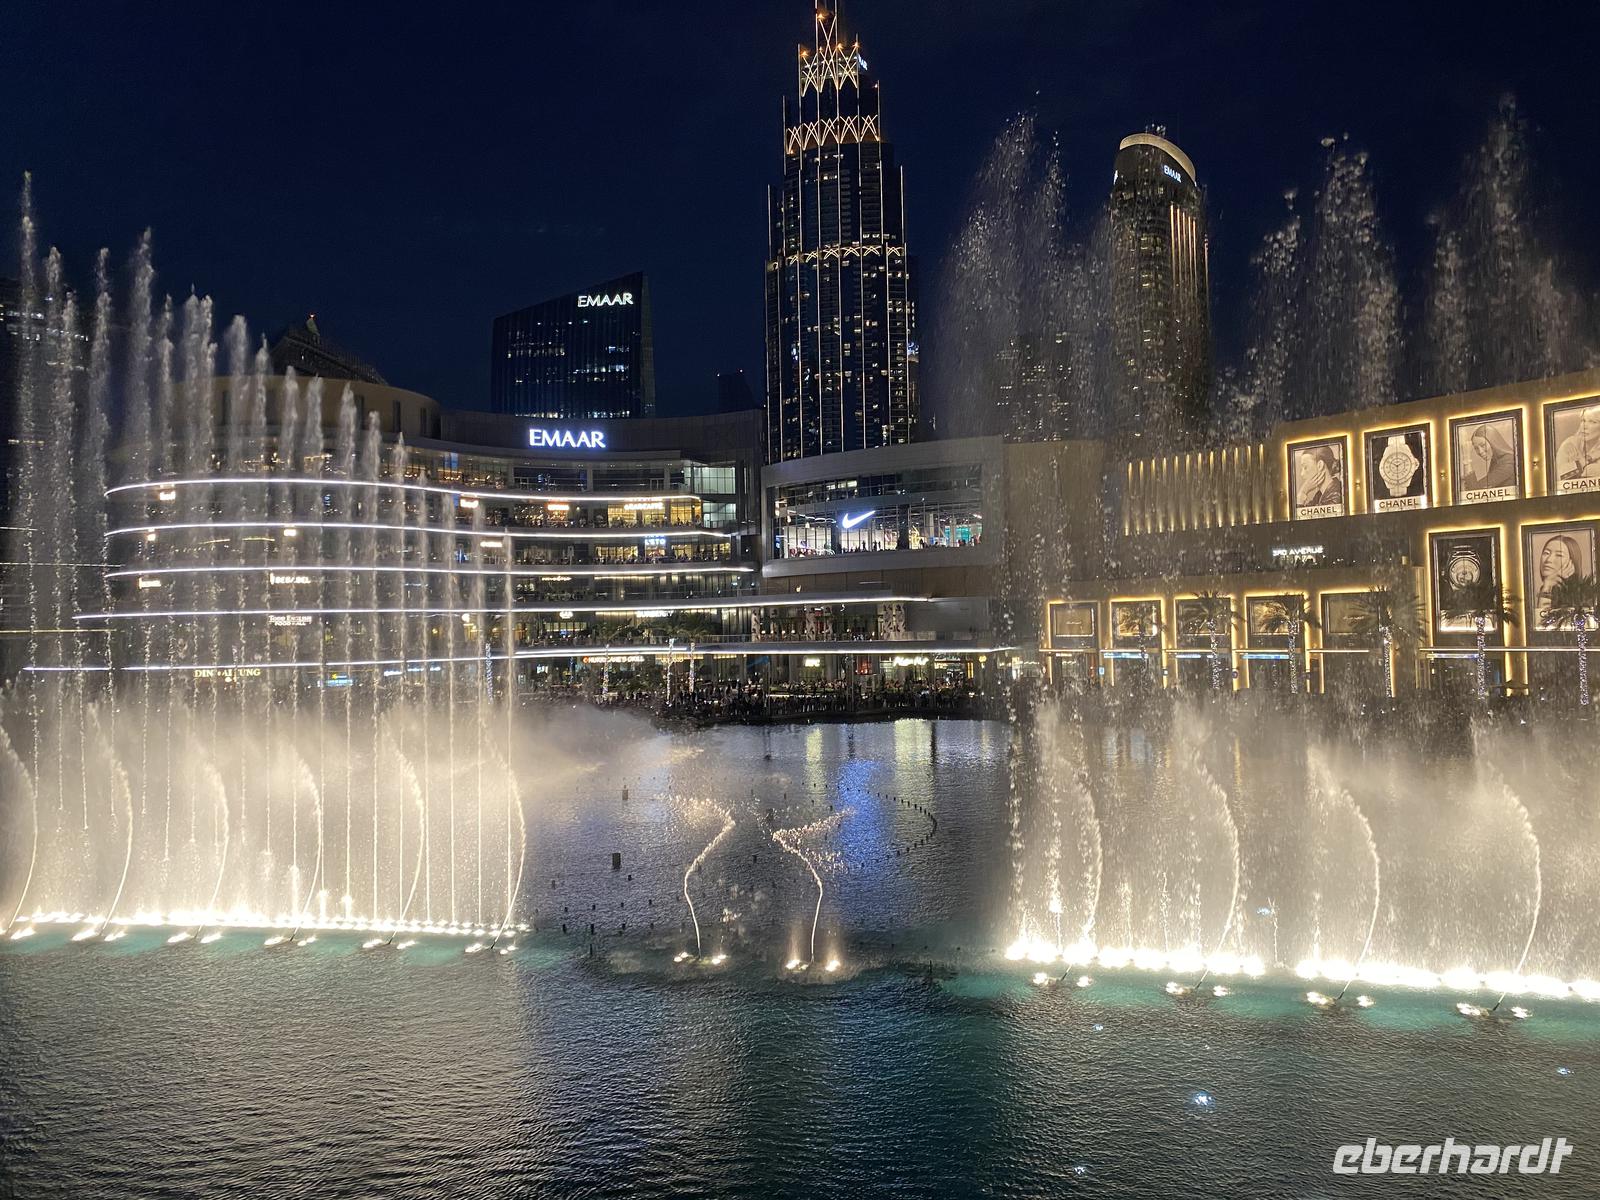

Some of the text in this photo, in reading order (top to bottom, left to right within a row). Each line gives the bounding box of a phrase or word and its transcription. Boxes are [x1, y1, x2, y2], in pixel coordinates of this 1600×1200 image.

[577, 292, 634, 308] EMAAR
[529, 428, 606, 448] EMAAR
[1562, 479, 1600, 490] CHAN
[1466, 489, 1511, 501] CHANEL
[1379, 499, 1419, 509] CHANEL
[1301, 506, 1338, 516] CHANEL
[195, 669, 214, 678] DIN
[234, 668, 261, 677] UNG
